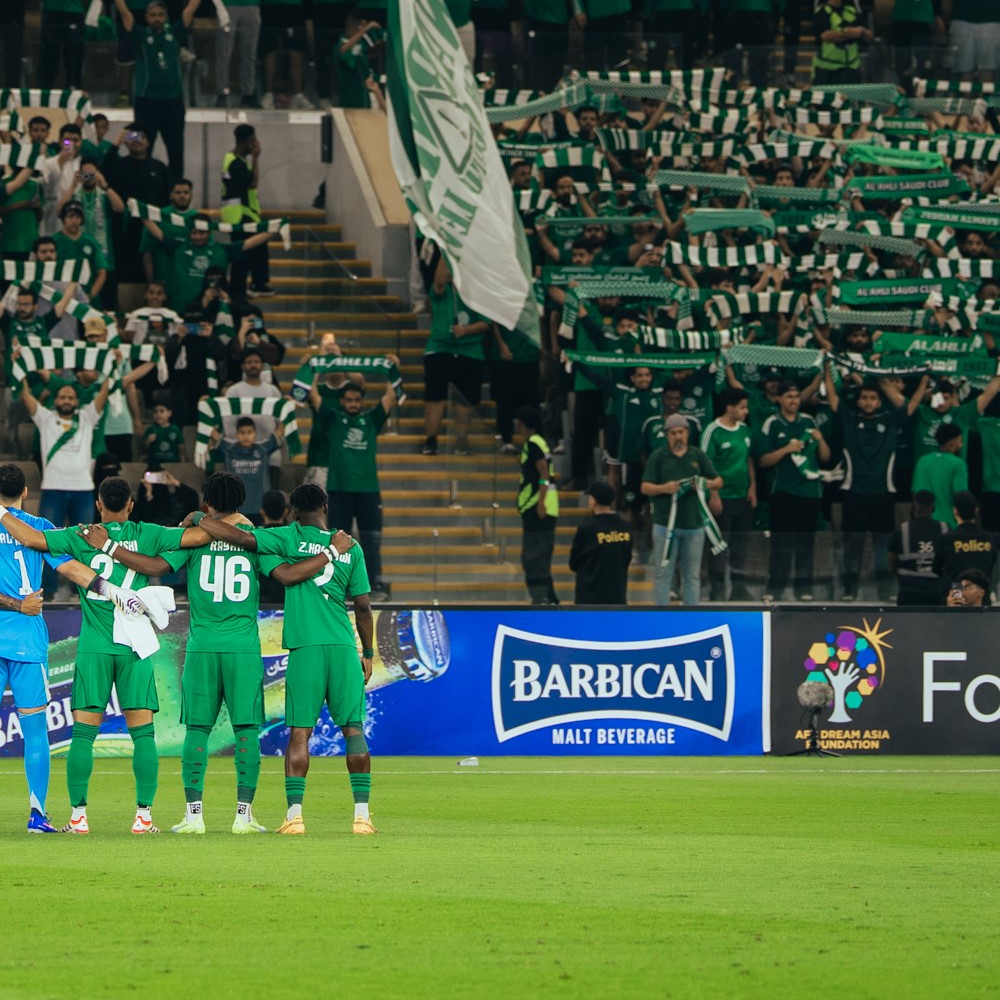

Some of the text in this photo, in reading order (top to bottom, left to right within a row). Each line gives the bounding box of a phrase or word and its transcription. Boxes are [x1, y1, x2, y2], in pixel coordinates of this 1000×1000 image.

[596, 530, 630, 544] Police
[918, 541, 934, 553] 36
[953, 539, 991, 553] Police
[14, 550, 34, 596] 1
[199, 554, 251, 602] 46
[510, 660, 714, 701] BARBICAN
[923, 652, 1000, 723] Fo
[552, 728, 675, 744] MALT BEVERAGE
[820, 730, 860, 739] DREAM
[863, 730, 890, 740] ASIA
[805, 740, 879, 749] FUNDATION
